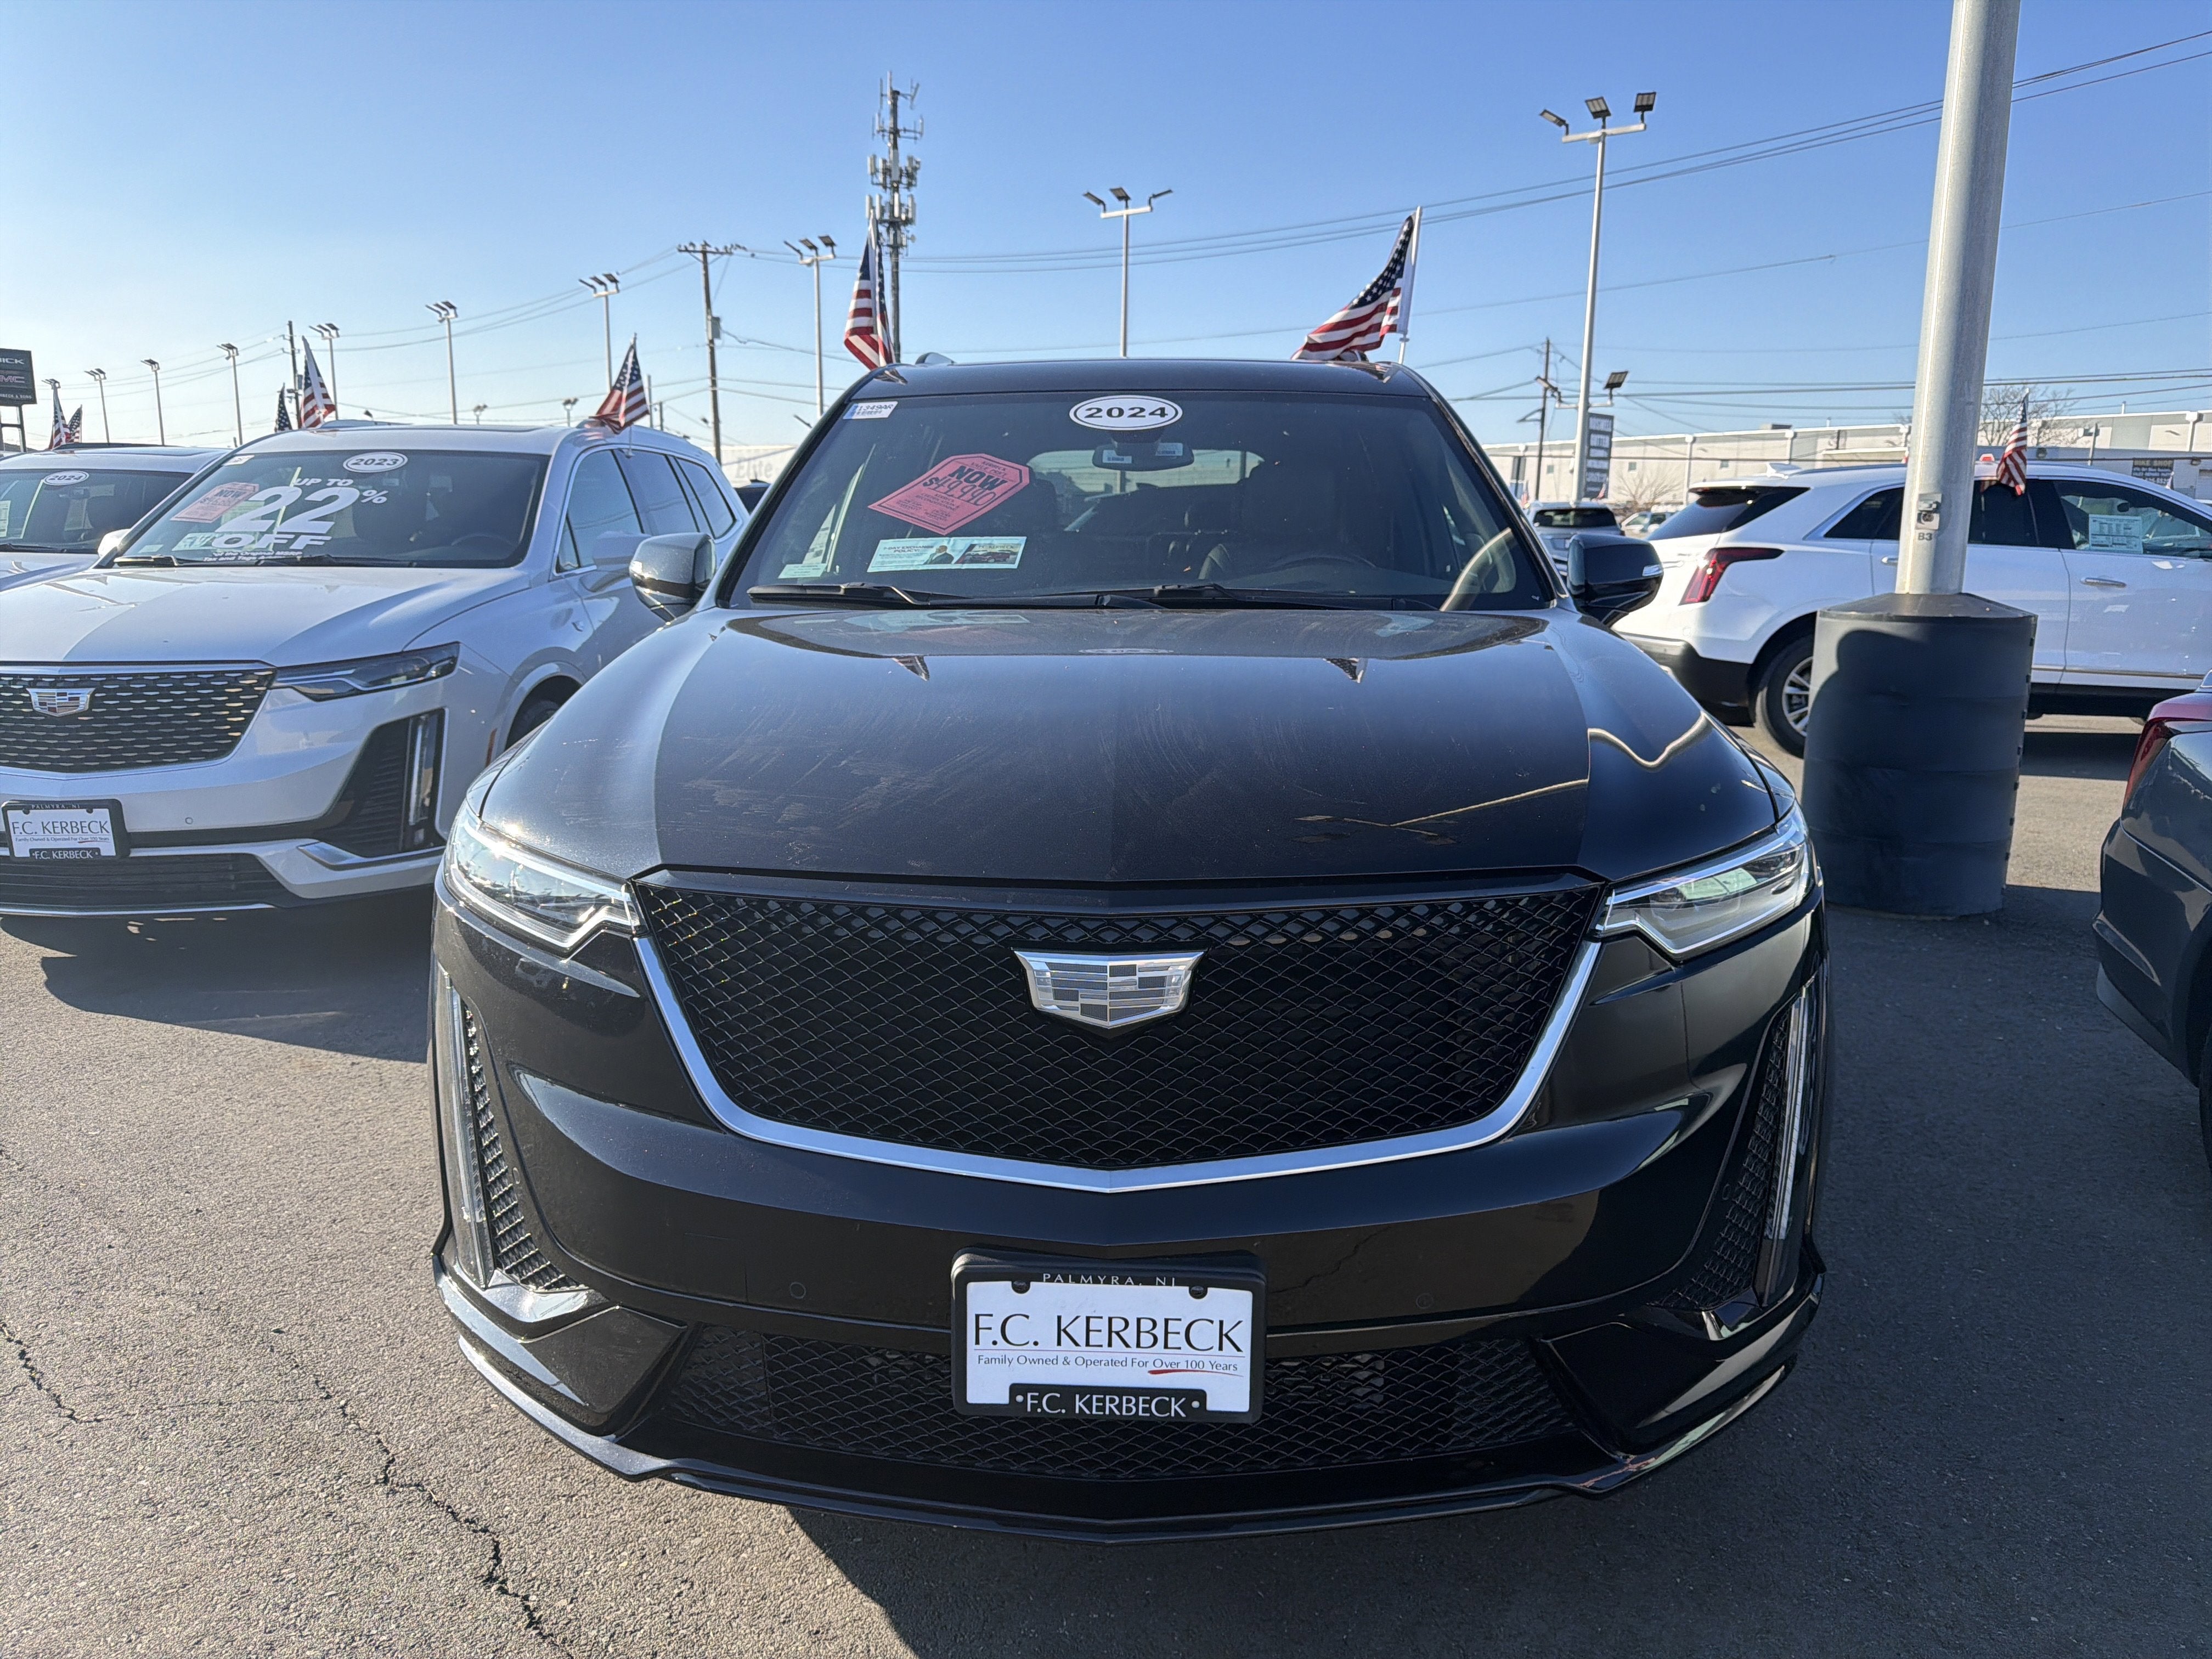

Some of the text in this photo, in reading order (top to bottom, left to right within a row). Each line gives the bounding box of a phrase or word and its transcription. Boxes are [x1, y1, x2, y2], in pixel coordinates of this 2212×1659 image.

[0, 375, 25, 383] MC
[1084, 407, 1169, 419] 2024
[351, 458, 400, 466] 2023
[735, 457, 774, 479] Elite
[326, 478, 354, 487] TO
[948, 465, 1008, 490] NOW
[211, 534, 332, 549] OFF
[12, 820, 110, 835] F.C. KERBECK
[35, 850, 93, 859] F.C. KERBECK
[1043, 1273, 1142, 1286] PALMYRA,
[974, 1313, 1244, 1353] F.C. KERBECK
[978, 1354, 1238, 1371] Family Owned & Operated For Over 100 Years
[1026, 1392, 1187, 1418] F.C. KERBECK
